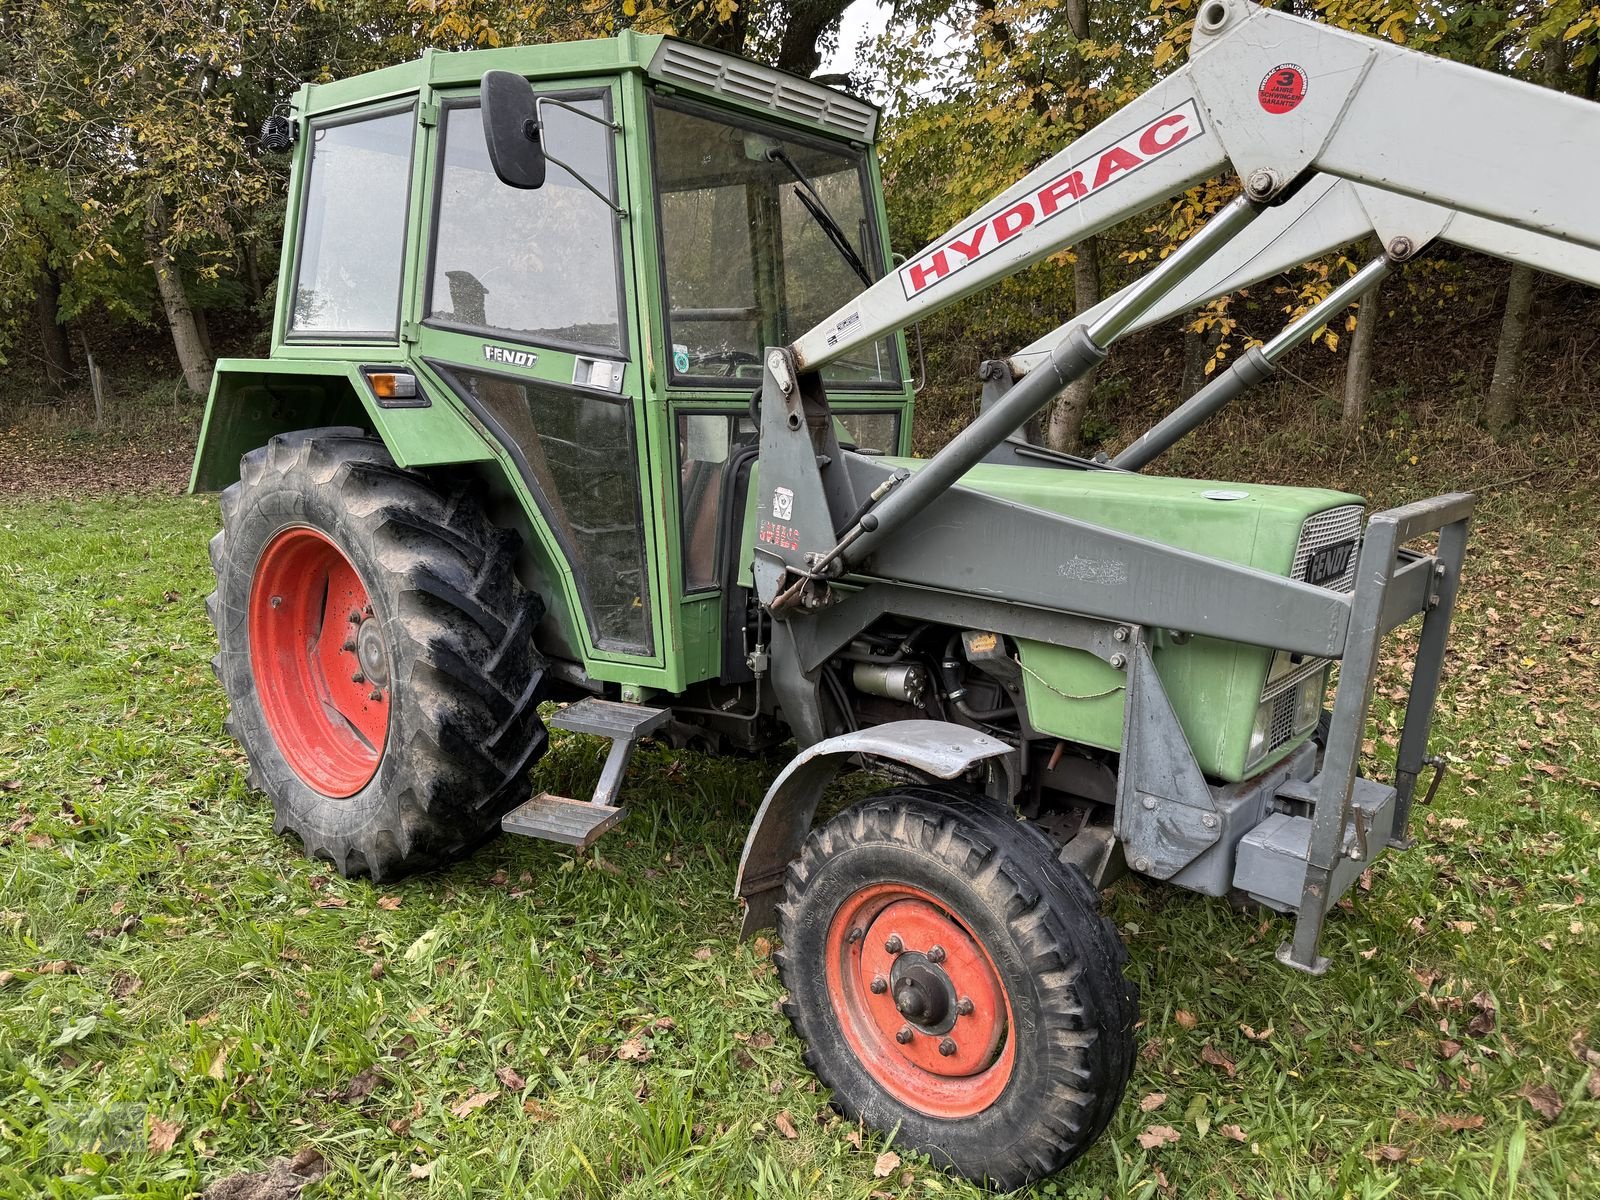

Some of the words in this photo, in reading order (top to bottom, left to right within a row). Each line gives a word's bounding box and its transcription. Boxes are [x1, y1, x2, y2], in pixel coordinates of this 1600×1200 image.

[1271, 86, 1295, 94] JAHRE
[1276, 71, 1295, 87] 3
[908, 114, 1189, 292] HYDRAC
[484, 345, 538, 368] FENDT
[1311, 544, 1354, 583] FENDT
